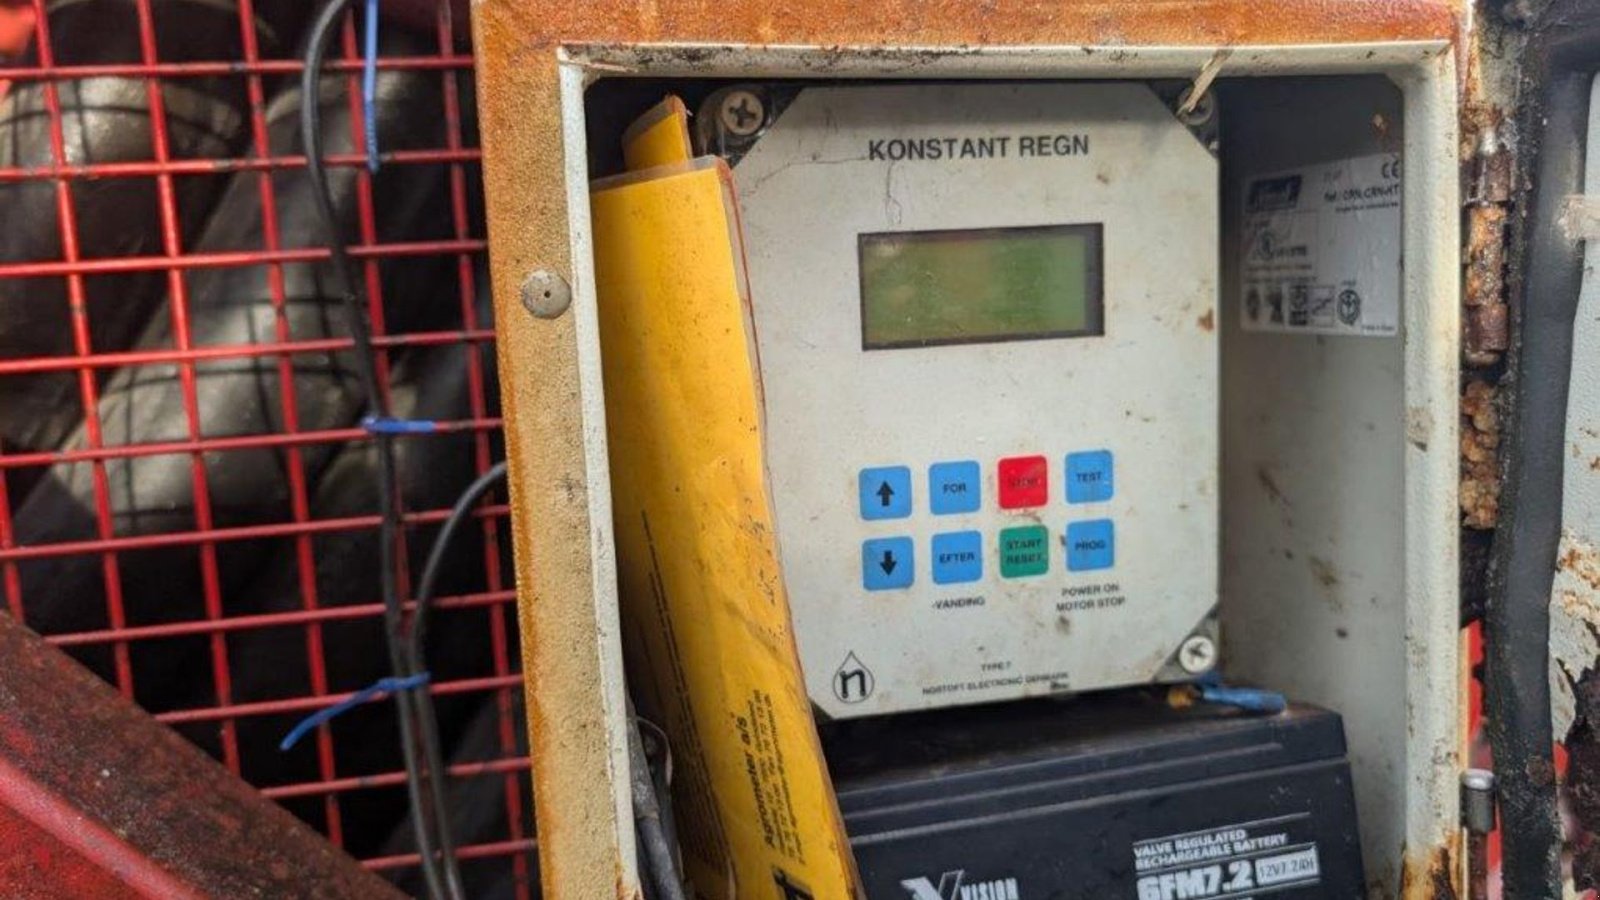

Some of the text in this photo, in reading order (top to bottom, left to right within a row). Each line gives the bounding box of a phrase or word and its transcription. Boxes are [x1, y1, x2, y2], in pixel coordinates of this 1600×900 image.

[869, 135, 1089, 160] KONSTANT REGN
[1077, 472, 1102, 483] TEST
[943, 483, 966, 493] FOR
[1008, 538, 1042, 550] START
[1075, 539, 1106, 551] PROG
[939, 552, 975, 563] EFTER
[1006, 553, 1042, 565] RESET
[1061, 583, 1120, 596] POWER ON
[1056, 596, 1125, 611] MOTOR STOP
[981, 662, 1005, 672] TYPE
[736, 716, 776, 849] Agrometer a/s
[1133, 829, 1246, 858] VALVE REGULATED
[1135, 833, 1287, 869] RECHARGEABLE BATTERY
[1136, 860, 1253, 900] 6FM7.2
